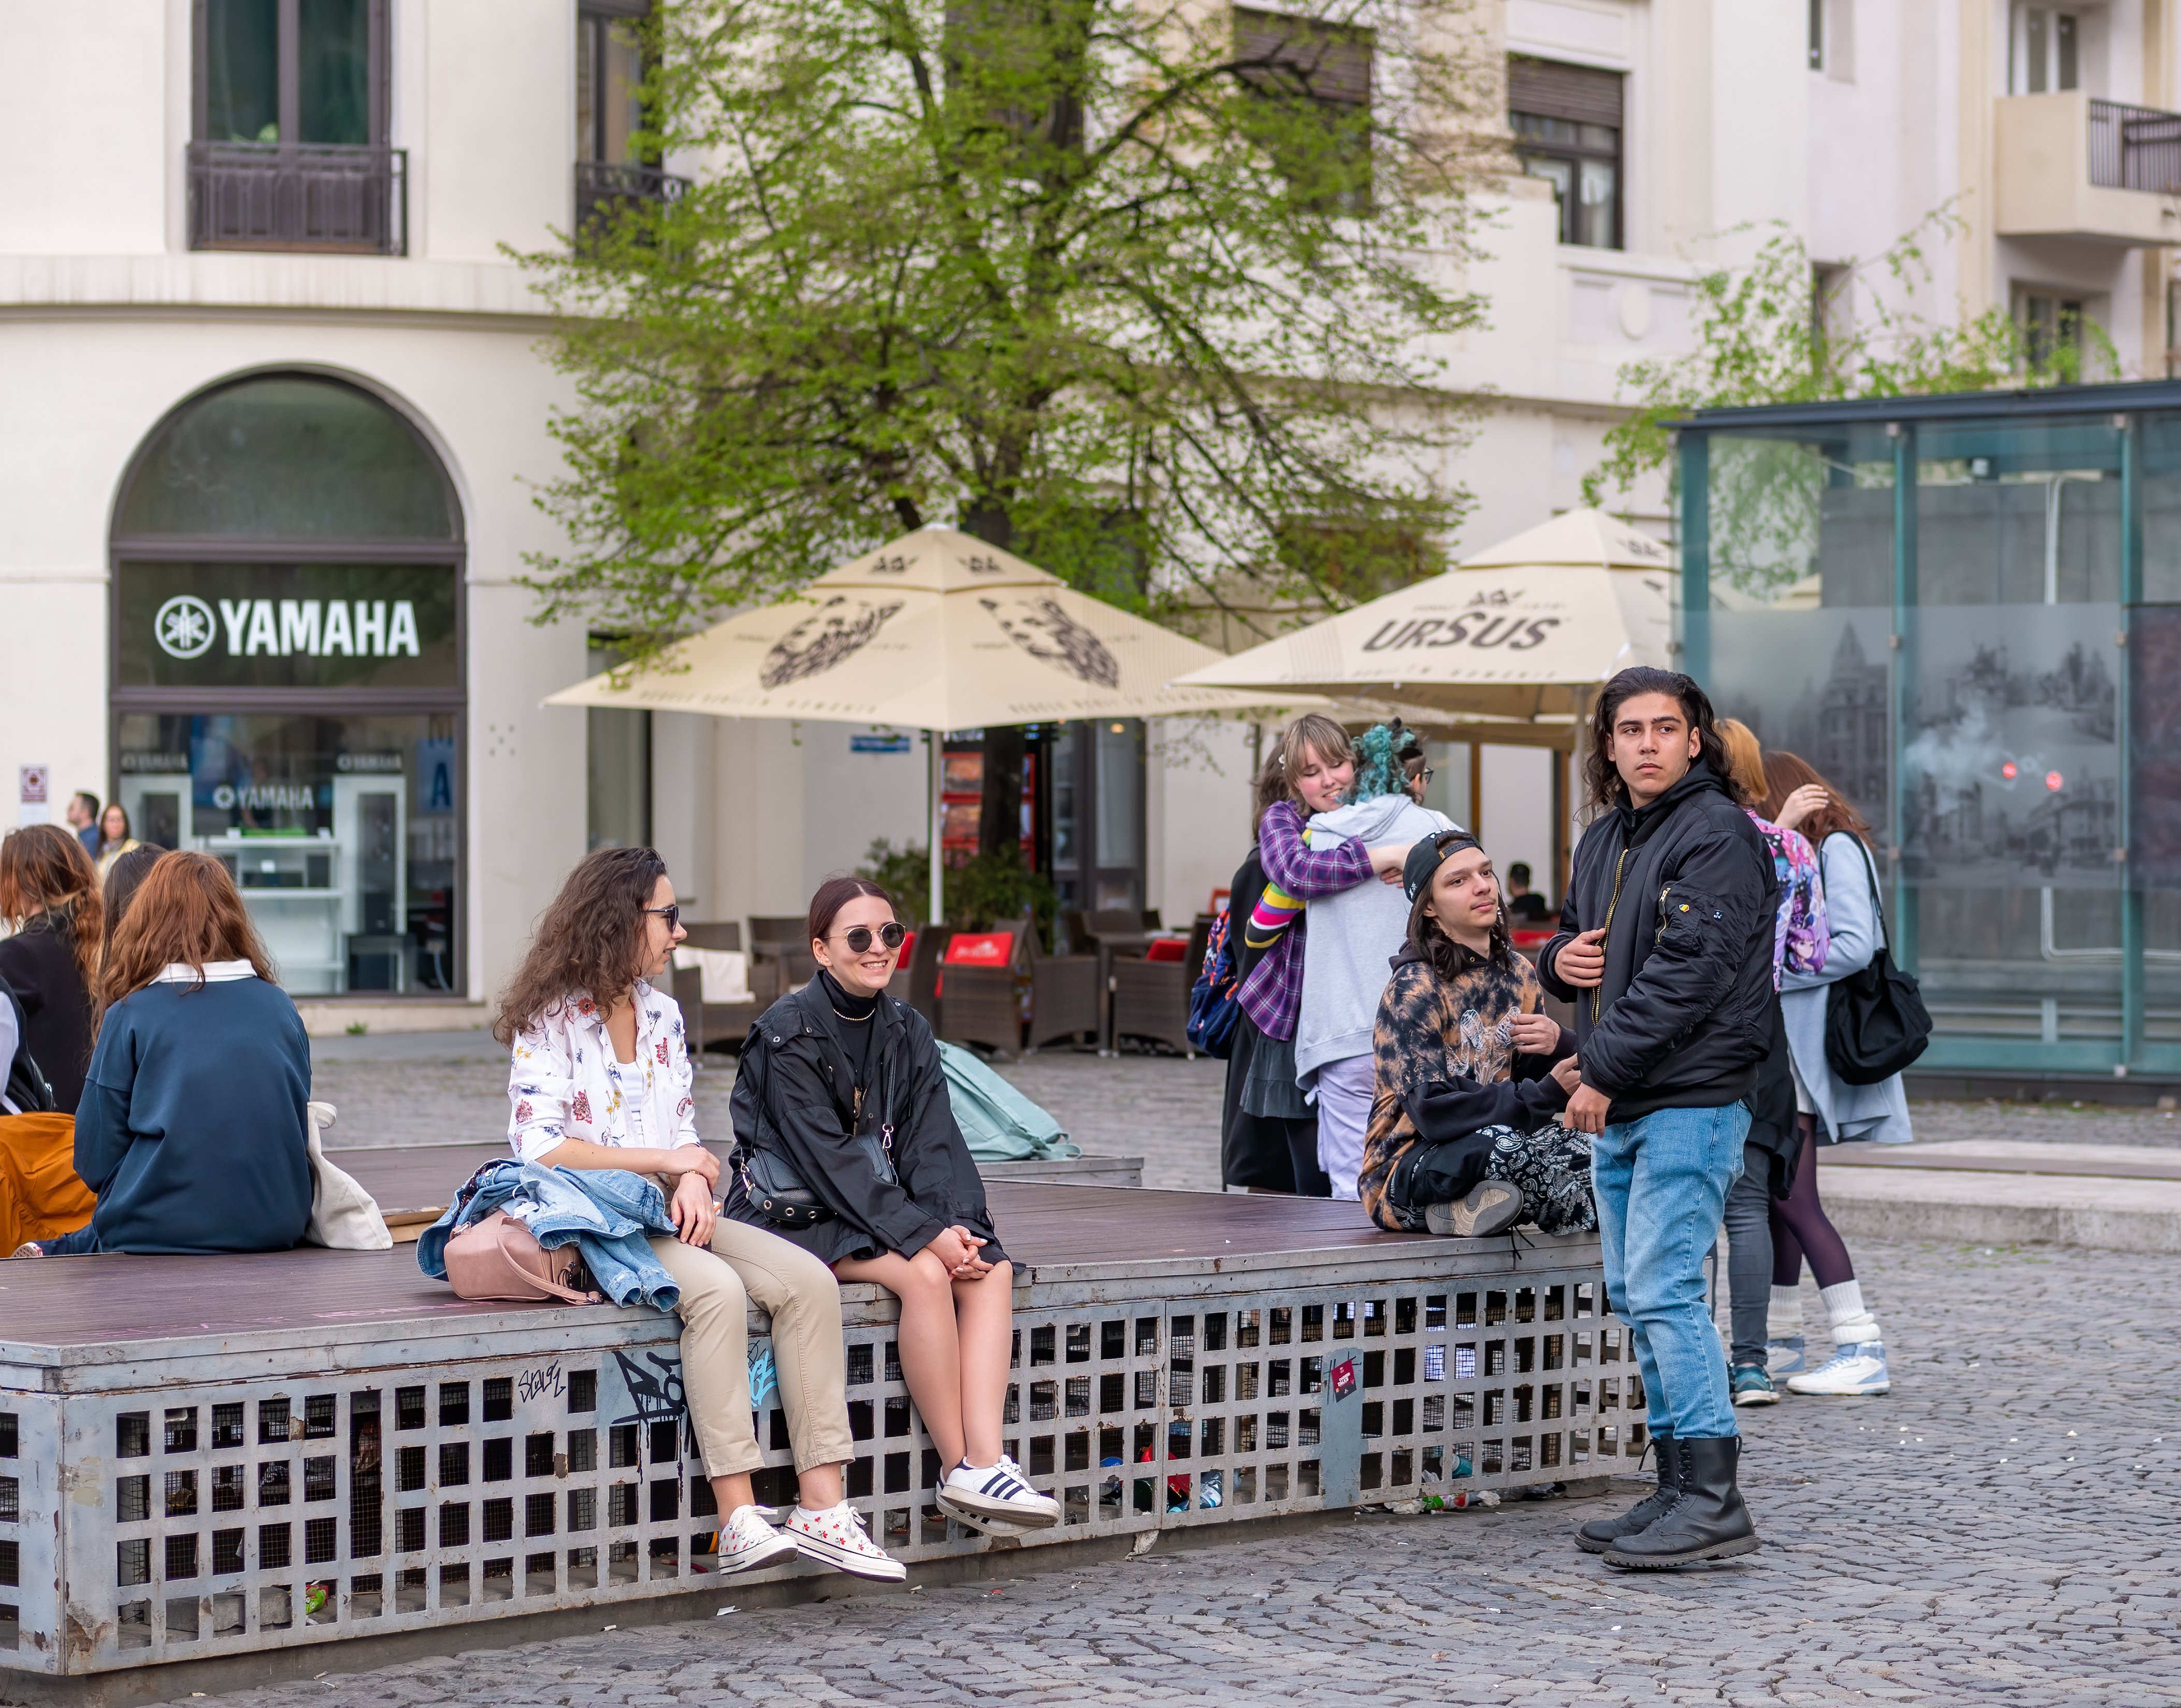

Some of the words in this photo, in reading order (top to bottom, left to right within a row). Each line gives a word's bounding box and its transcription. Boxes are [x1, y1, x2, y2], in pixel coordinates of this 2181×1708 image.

[219, 599, 420, 657] YAMAHA
[1362, 611, 1561, 652] URSUS
[237, 785, 314, 810] YAMAHA
